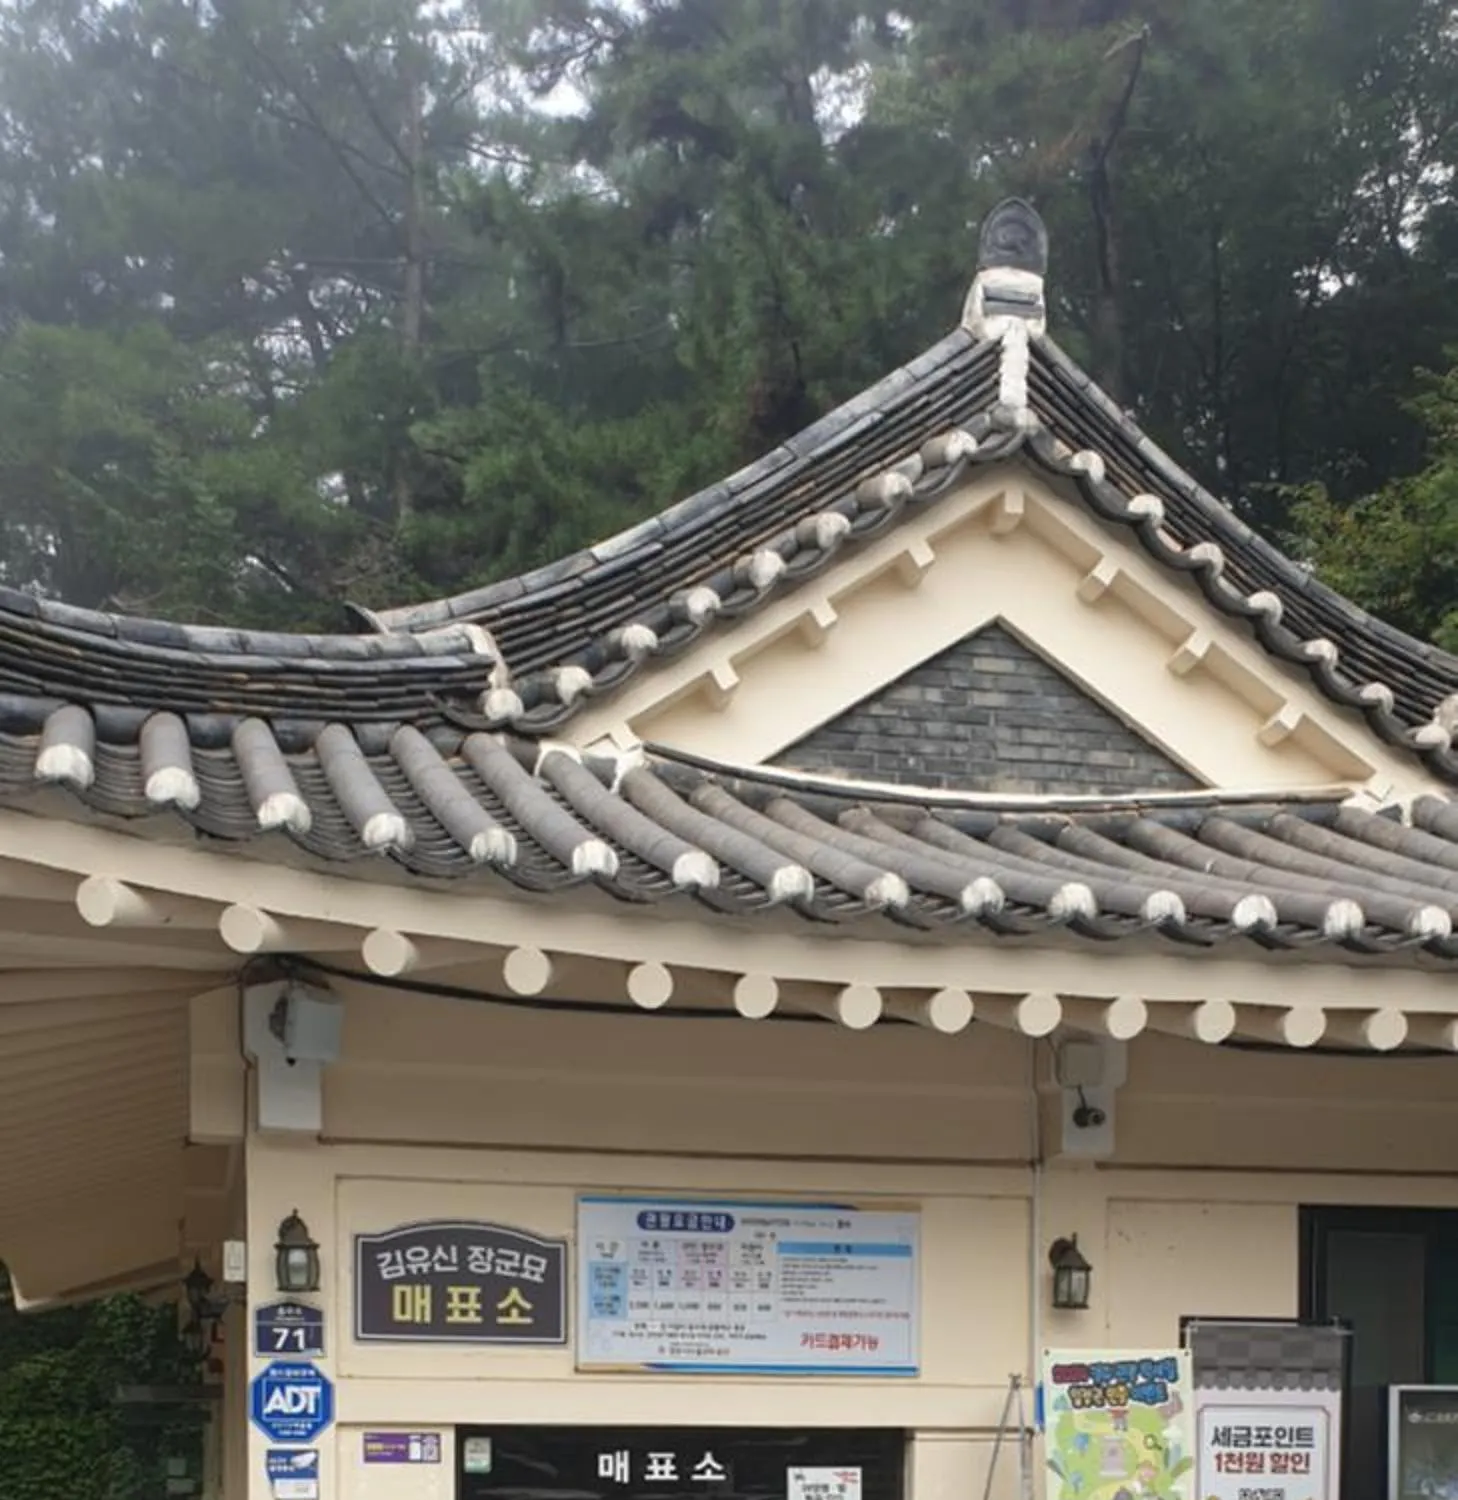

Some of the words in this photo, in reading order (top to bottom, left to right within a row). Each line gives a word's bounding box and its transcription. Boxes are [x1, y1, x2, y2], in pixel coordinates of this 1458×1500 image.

[376, 1245, 459, 1280] 김유신
[467, 1246, 548, 1283] 장군묘
[272, 1327, 305, 1350] 71
[801, 1332, 880, 1352] 카드결제가능
[262, 1385, 322, 1415] ADT
[1211, 1425, 1315, 1449] 세금포인트
[1214, 1452, 1265, 1474] 1천원
[1269, 1452, 1311, 1474] 할인
